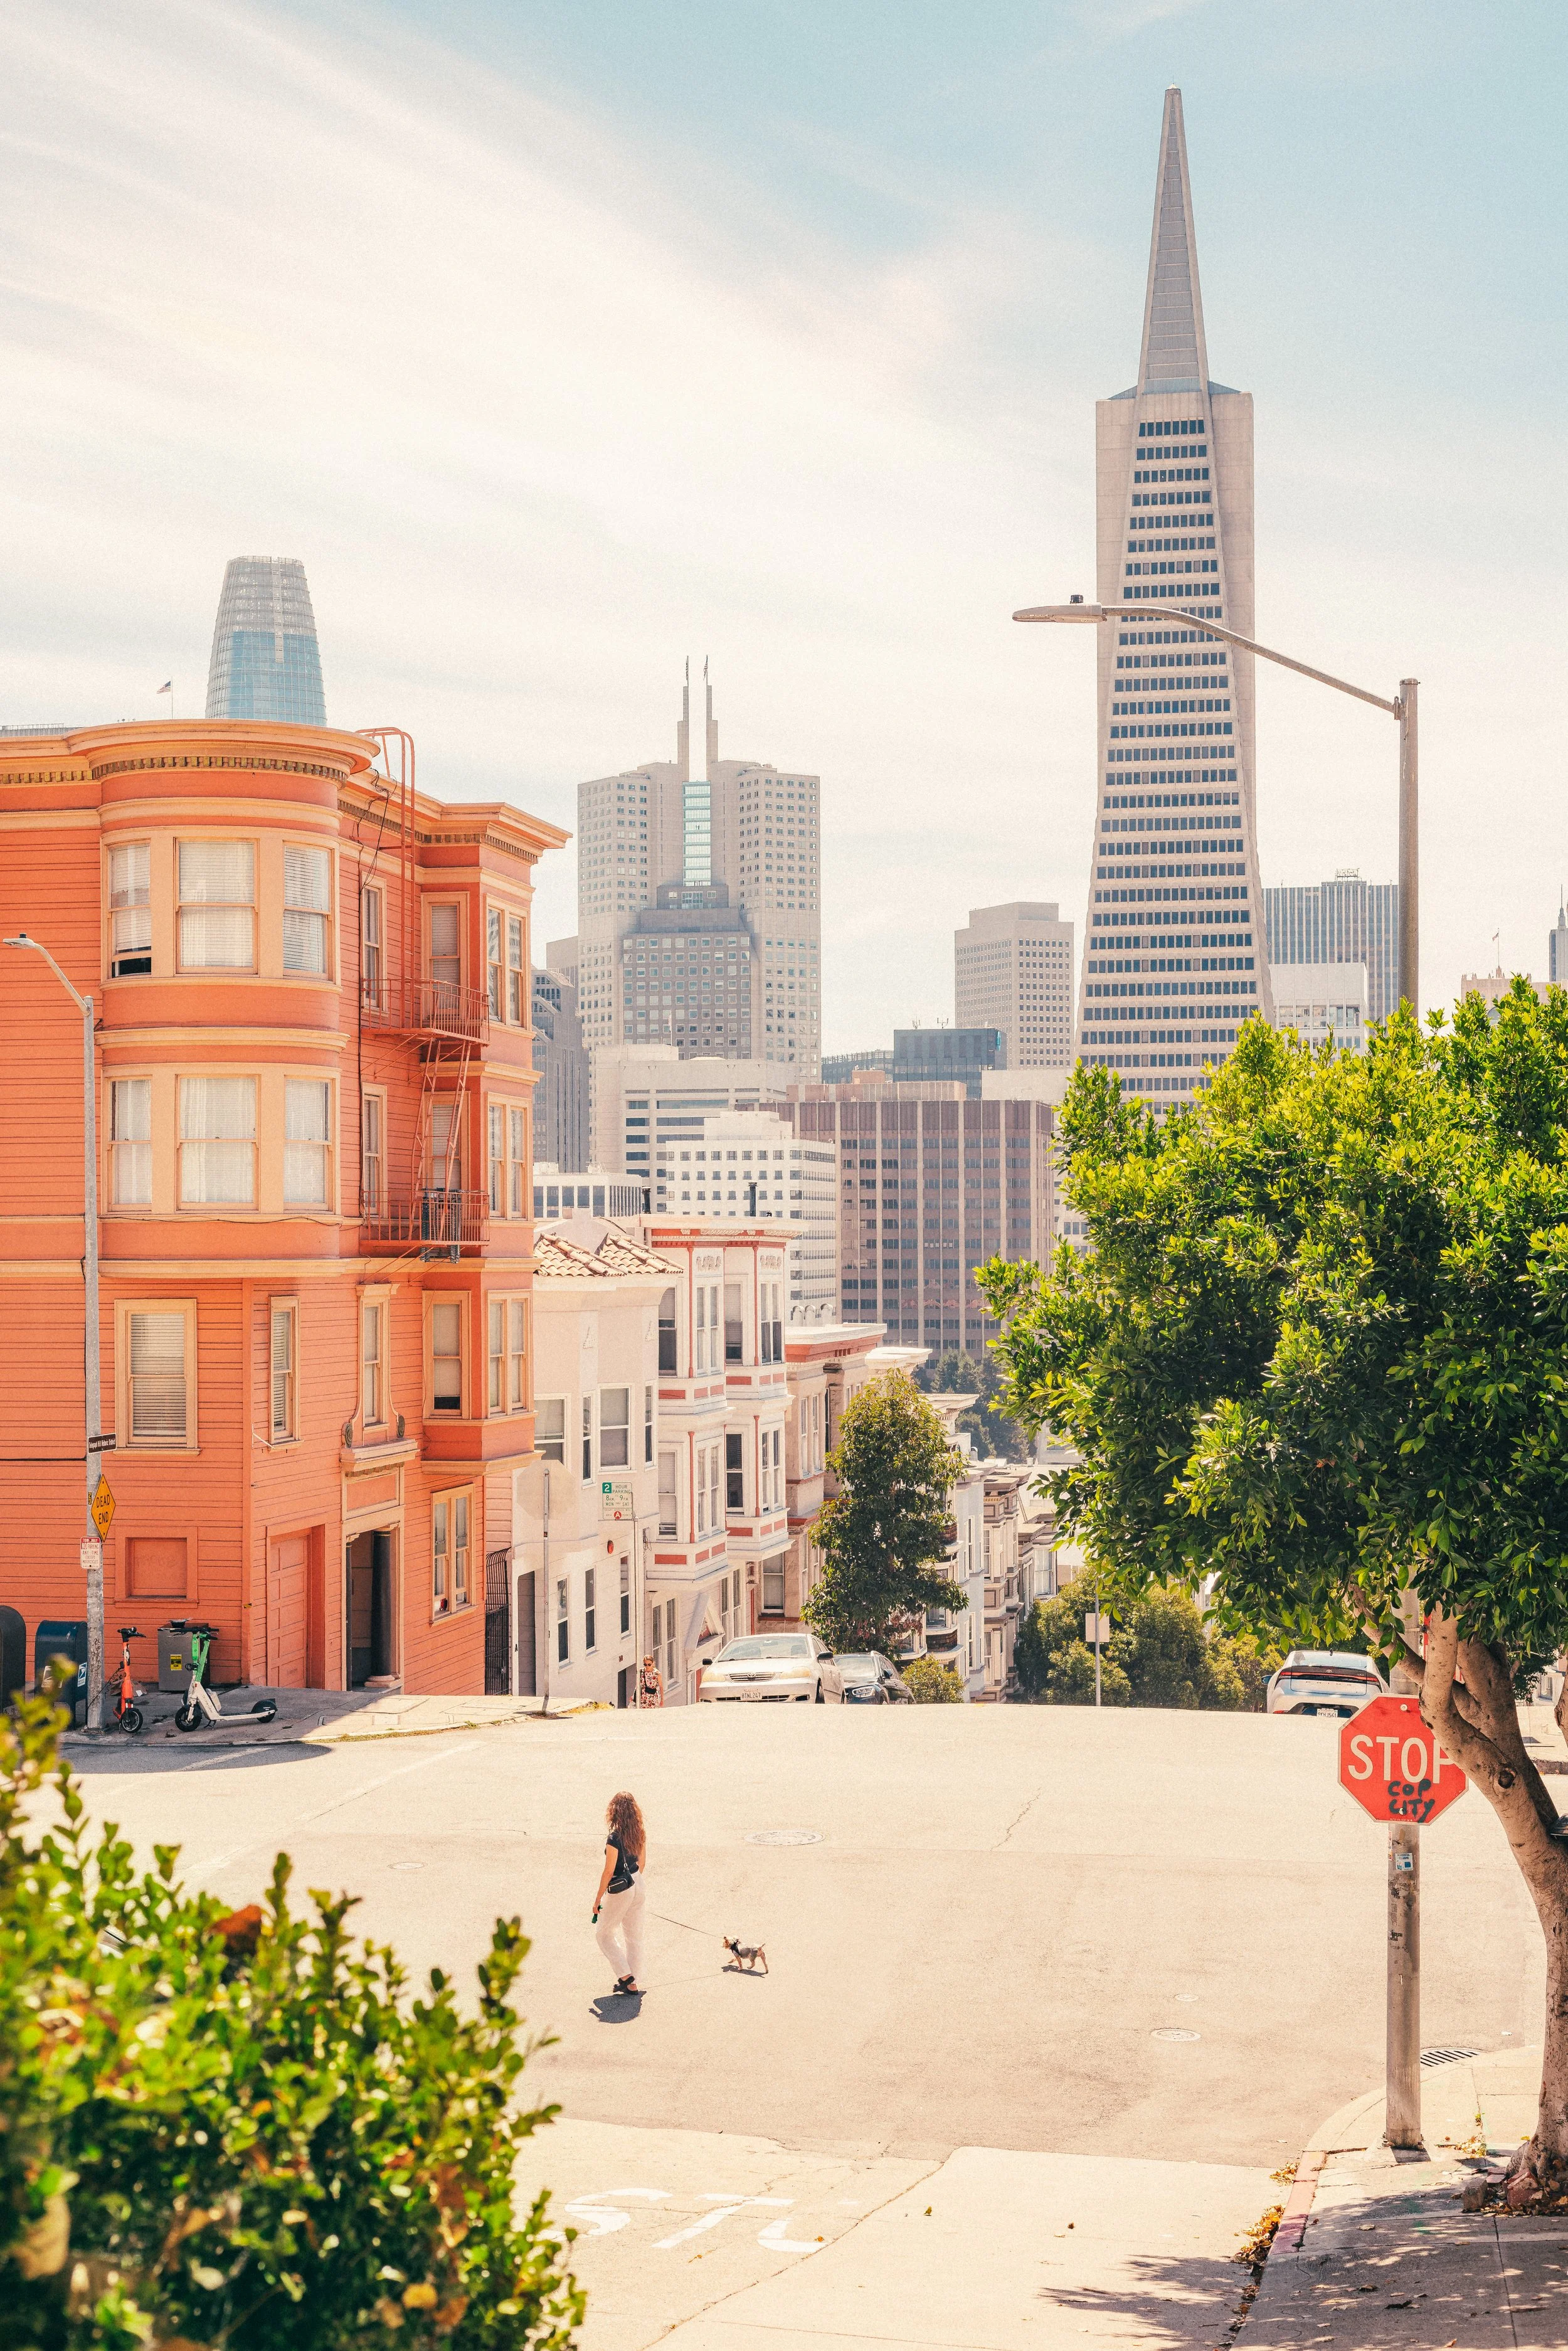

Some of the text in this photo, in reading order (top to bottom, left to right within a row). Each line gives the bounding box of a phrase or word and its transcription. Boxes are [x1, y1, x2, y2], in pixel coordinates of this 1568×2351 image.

[604, 1484, 610, 1492] 2
[96, 1494, 110, 1509] DEAD
[98, 1511, 109, 1524] END
[1388, 1778, 1432, 1798] COP
[1388, 1798, 1436, 1823] CITY
